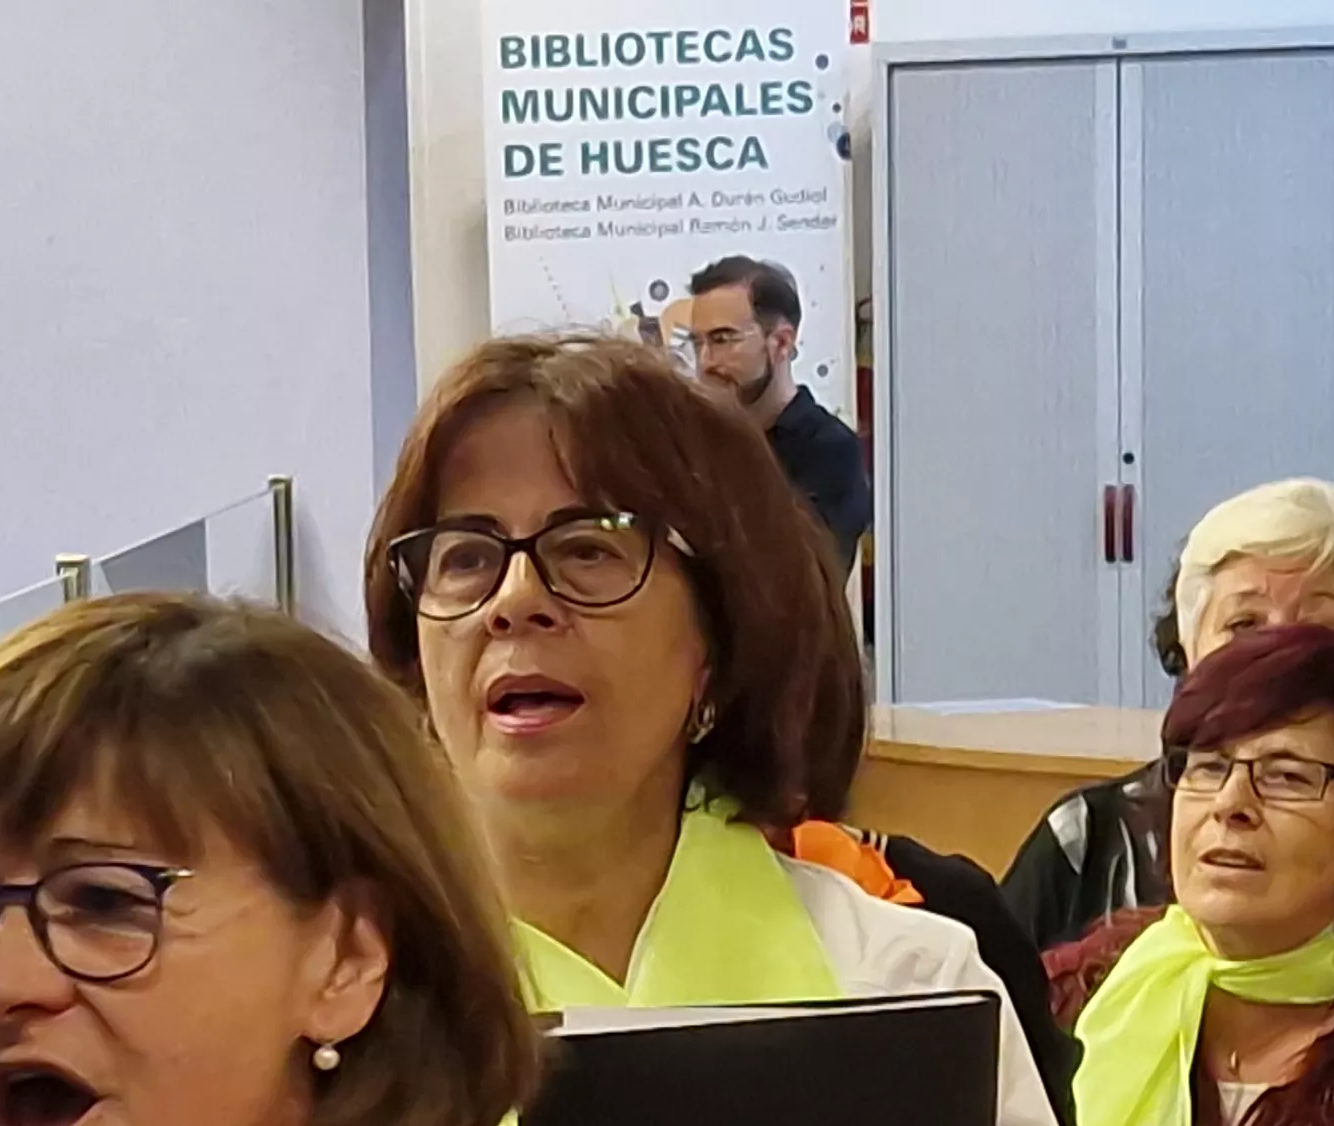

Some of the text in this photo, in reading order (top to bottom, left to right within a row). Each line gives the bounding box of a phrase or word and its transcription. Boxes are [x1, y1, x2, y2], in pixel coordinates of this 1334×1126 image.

[500, 28, 794, 69] BIBLIOTECAS
[501, 80, 813, 124] MUNICIPALES
[504, 135, 768, 178] DE HUESCA
[503, 197, 591, 215] Biblioteca
[596, 193, 683, 213] Municipal
[503, 225, 591, 241] Biblioteca
[596, 219, 684, 240] Municipal
